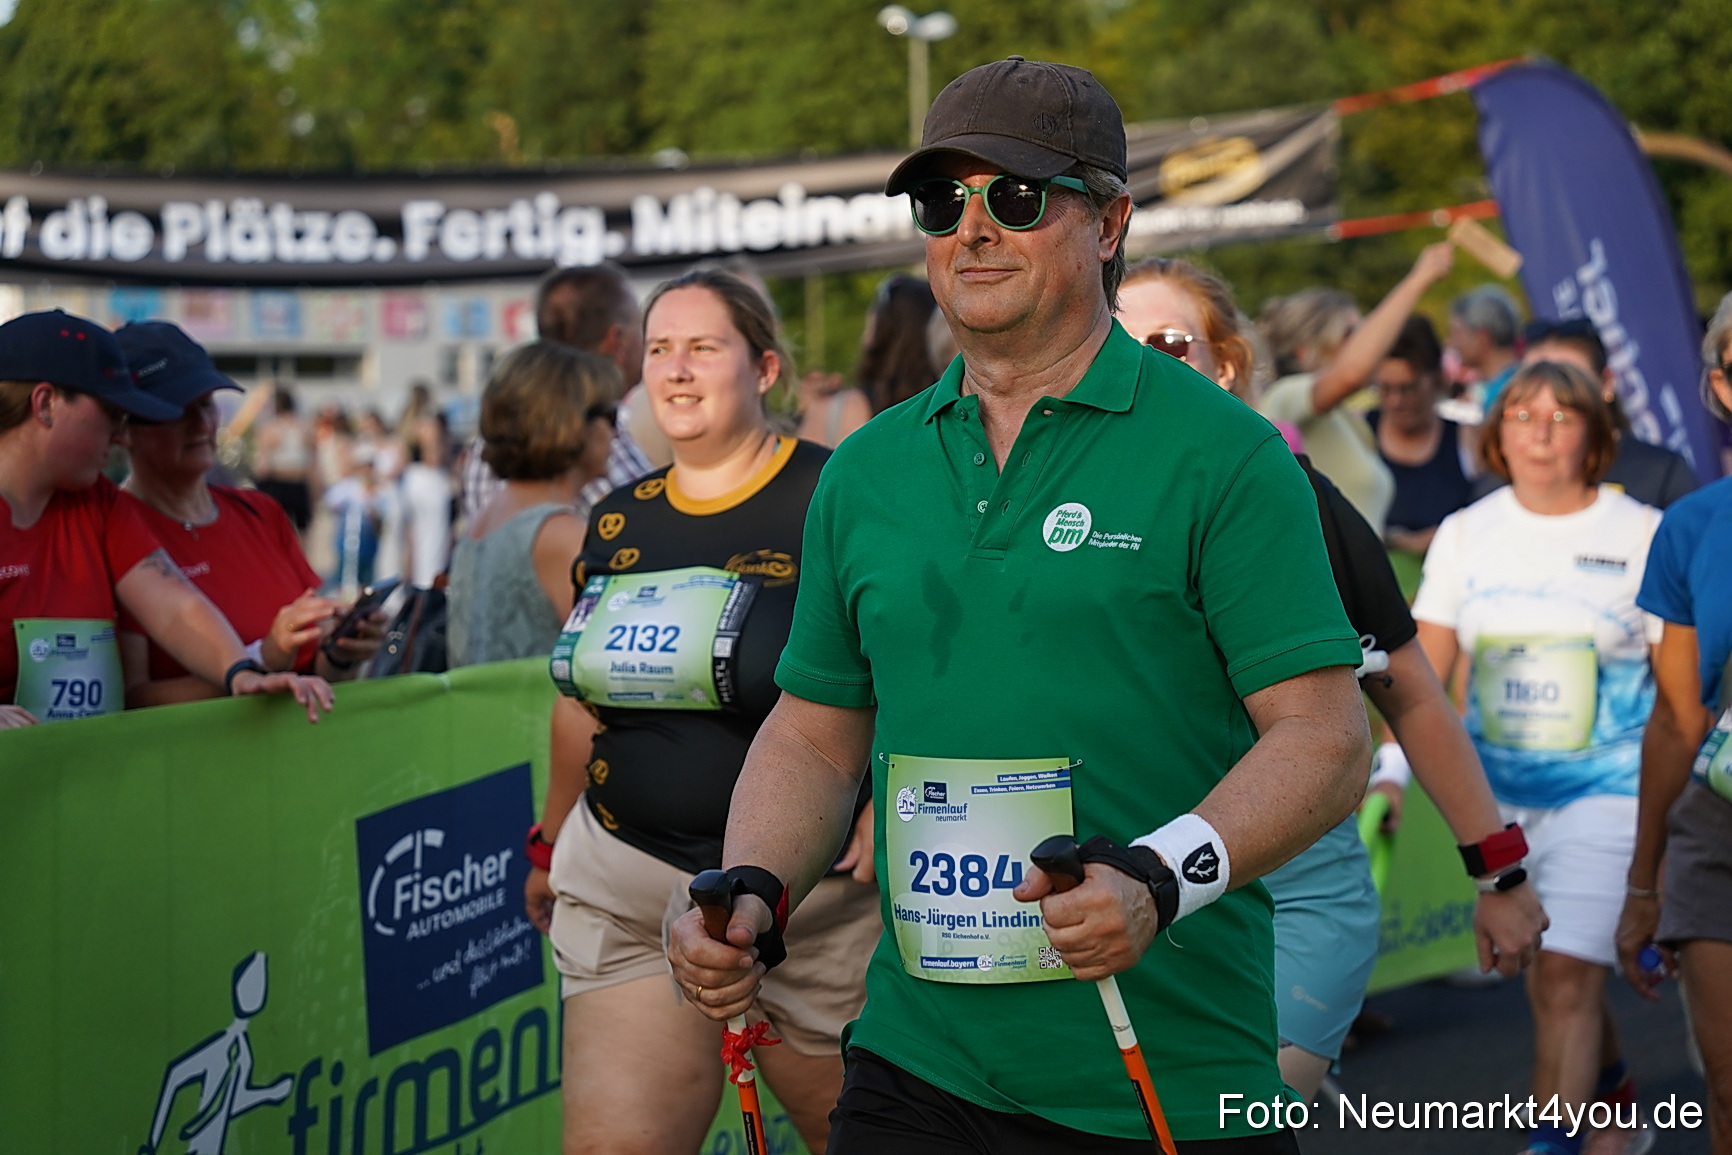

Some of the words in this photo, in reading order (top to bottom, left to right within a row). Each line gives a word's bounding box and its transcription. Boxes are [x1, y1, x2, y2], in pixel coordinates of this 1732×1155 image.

[0, 195, 31, 259] f
[40, 194, 154, 261] die
[161, 197, 397, 263] Plätze.
[402, 190, 625, 268] Fertig.
[631, 181, 914, 255] Miteina
[1056, 518, 1085, 527] Mensch
[1047, 526, 1083, 545] pm
[605, 624, 680, 653] 2132
[610, 661, 636, 674] Julia
[639, 662, 673, 674] Raum
[52, 679, 103, 708] 790
[918, 803, 968, 814] Firmenlauf
[935, 814, 967, 822] neumarkt
[393, 847, 513, 921] Fischer
[909, 850, 1023, 898] 2384
[406, 887, 506, 942] AUTOMOBILE
[894, 903, 977, 931] Hans-Jürgen
[982, 911, 1046, 931] Lindin
[952, 932, 980, 940] Eichenhof
[922, 957, 975, 968] firmenlauf.bayern
